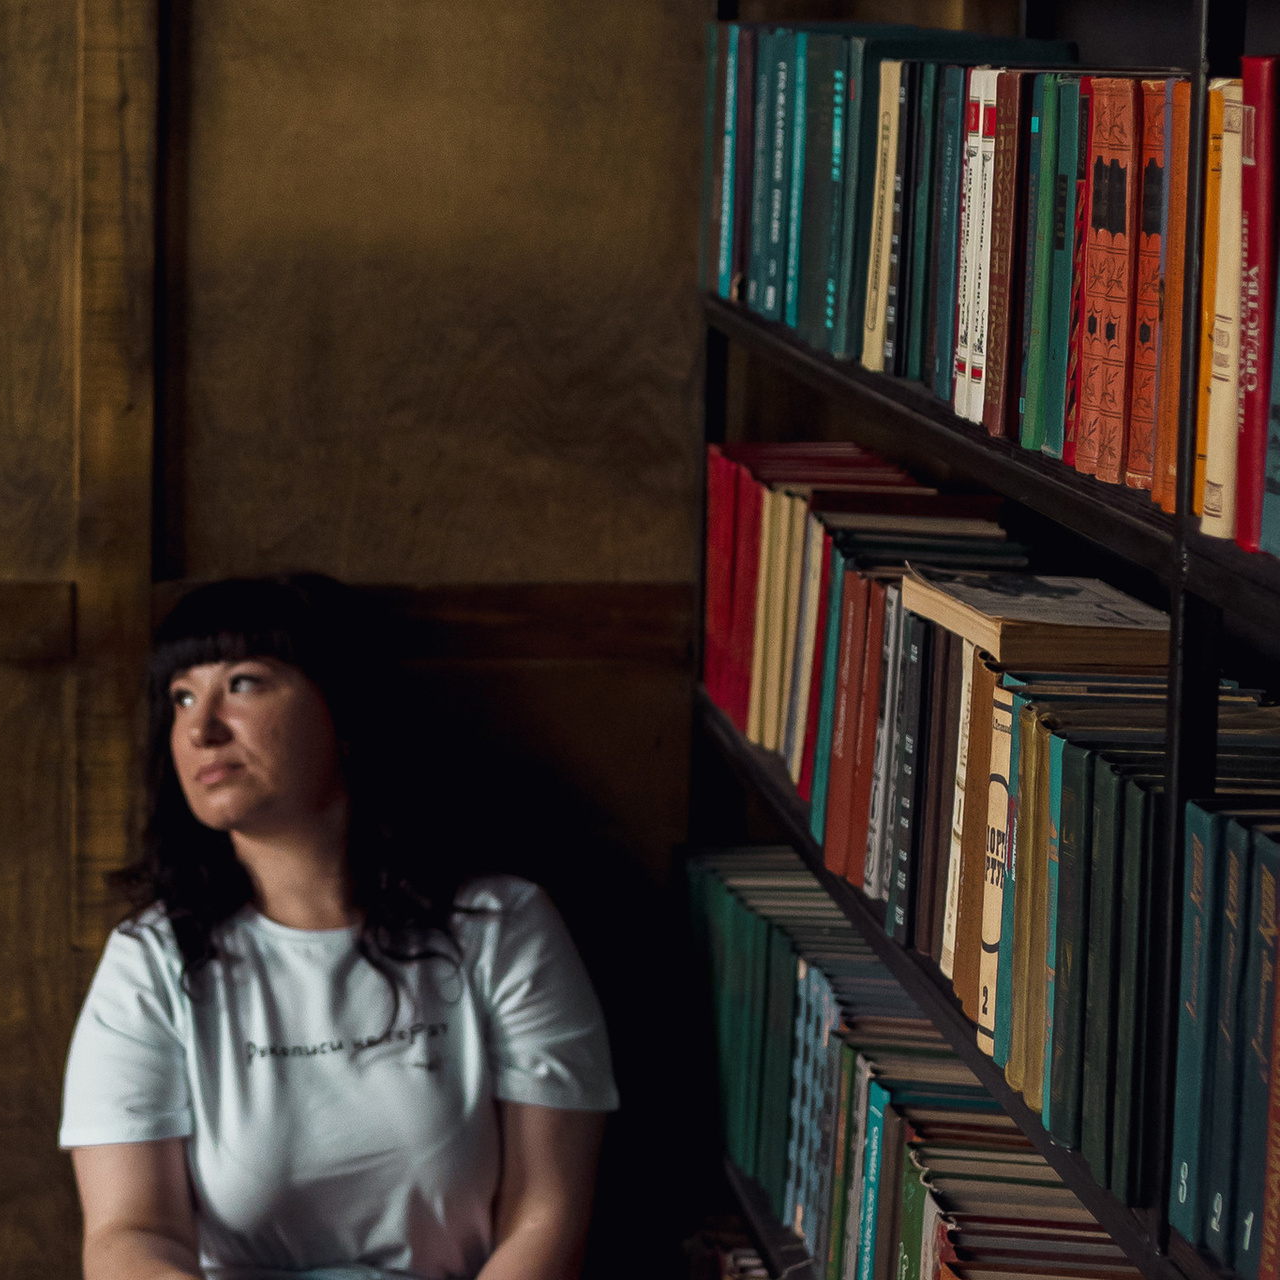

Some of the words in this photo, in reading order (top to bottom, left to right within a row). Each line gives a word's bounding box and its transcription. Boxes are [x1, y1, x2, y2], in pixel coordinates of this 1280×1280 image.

[996, 134, 1013, 275] ШОЛОХОВ
[1246, 265, 1259, 392] СРЕДСТВА
[981, 984, 988, 1015] 2
[1210, 1191, 1222, 1232] 2
[1242, 1210, 1254, 1251] 1
